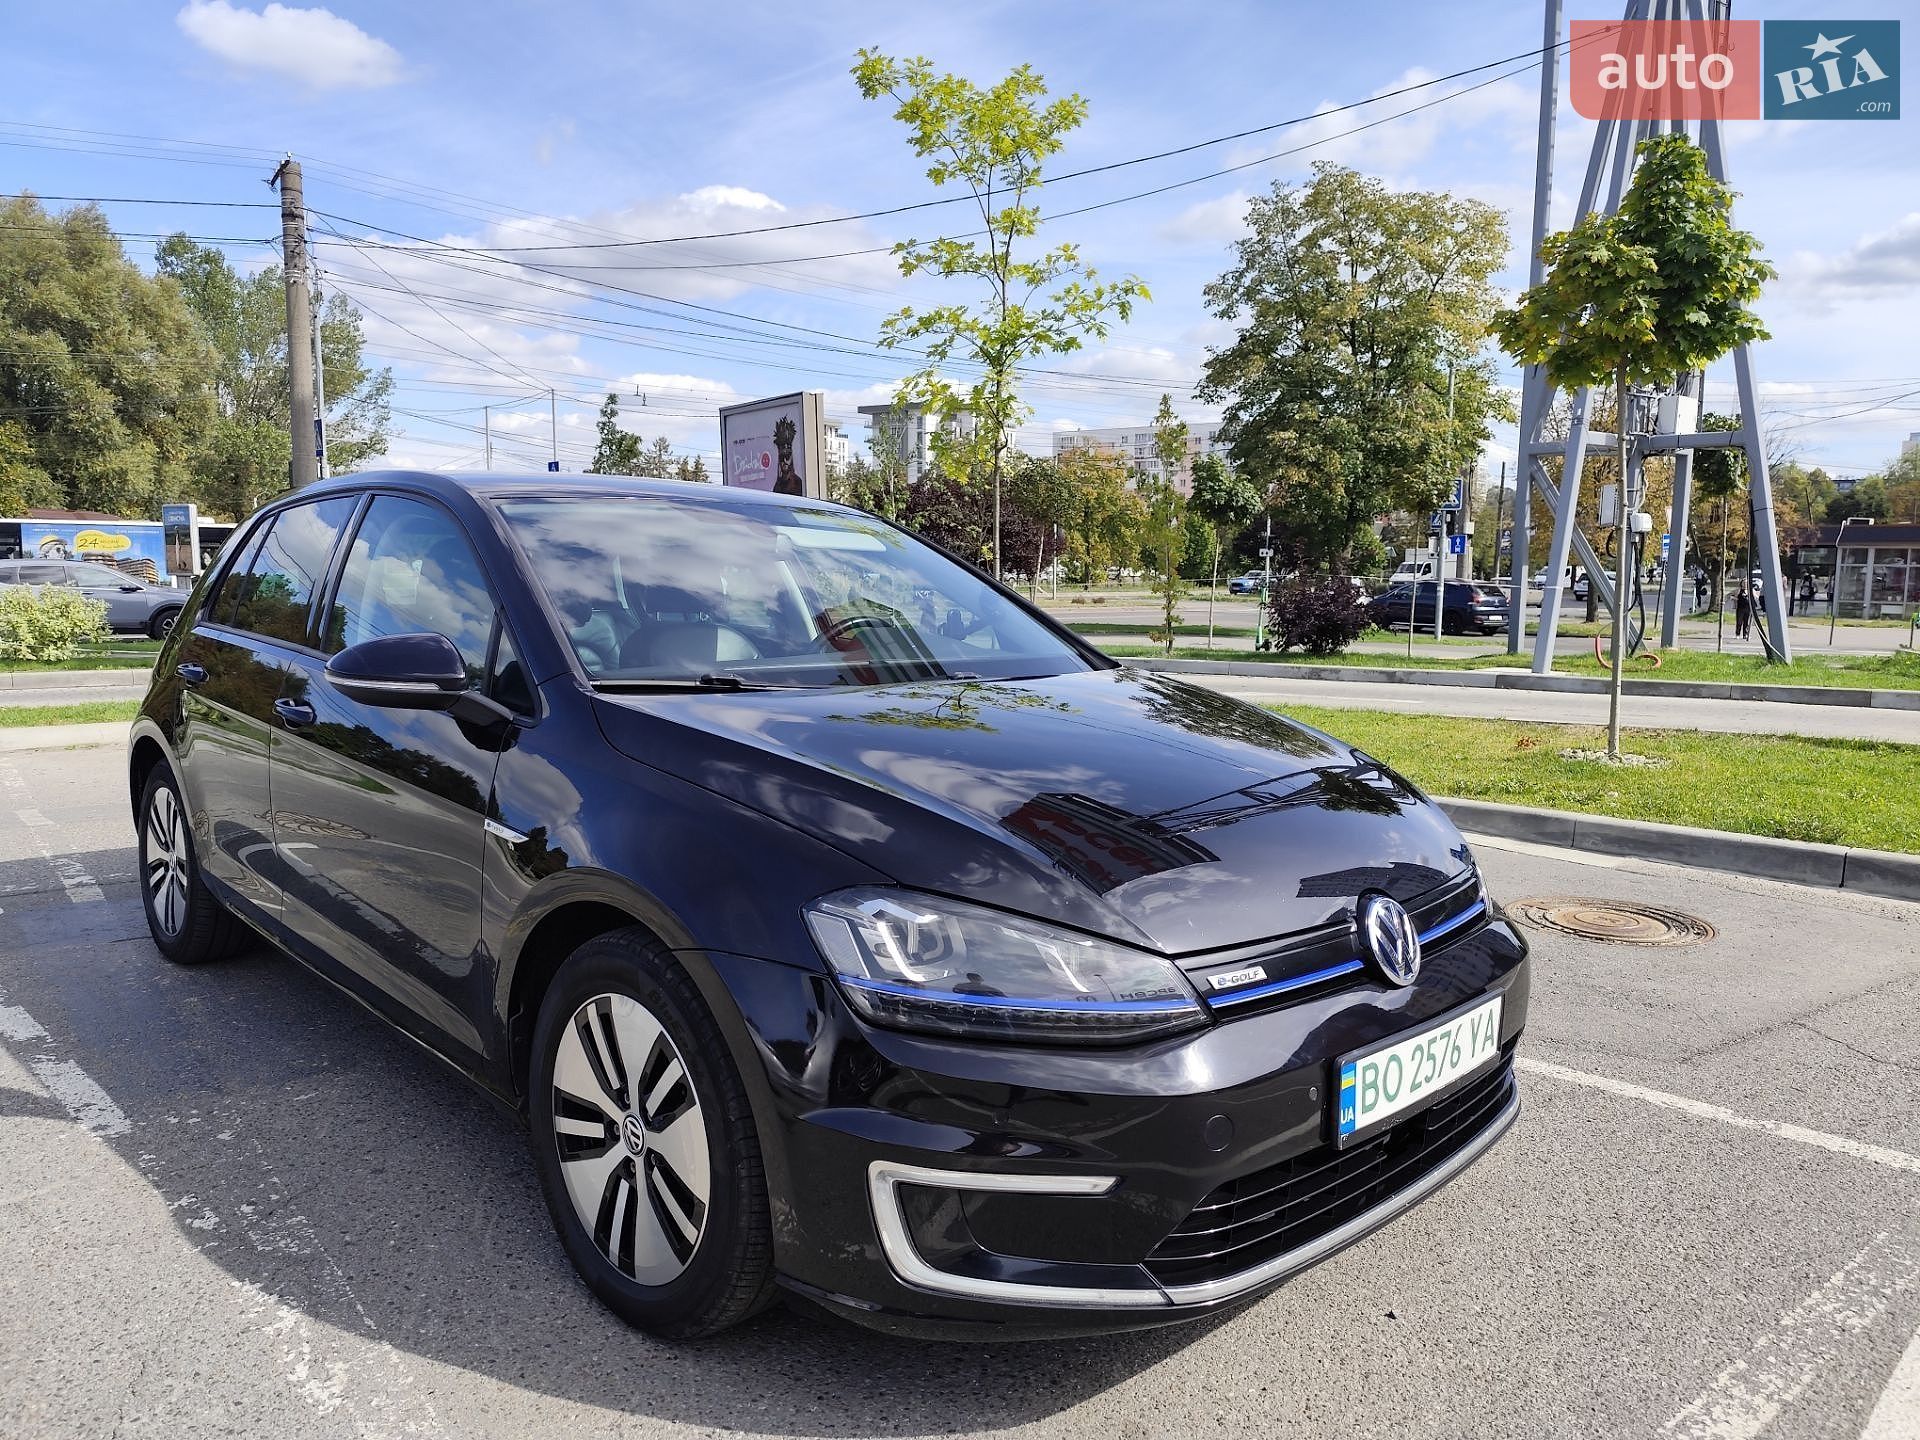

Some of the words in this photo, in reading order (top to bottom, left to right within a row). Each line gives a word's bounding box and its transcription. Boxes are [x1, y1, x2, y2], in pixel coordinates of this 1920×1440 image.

[77, 538, 99, 549] 24
[1218, 969, 1260, 985] e-GOLF
[1361, 1053, 1403, 1115] BO
[1409, 1023, 1463, 1094] 2576
[1471, 1008, 1495, 1058] YA
[1341, 1106, 1354, 1124] UA
